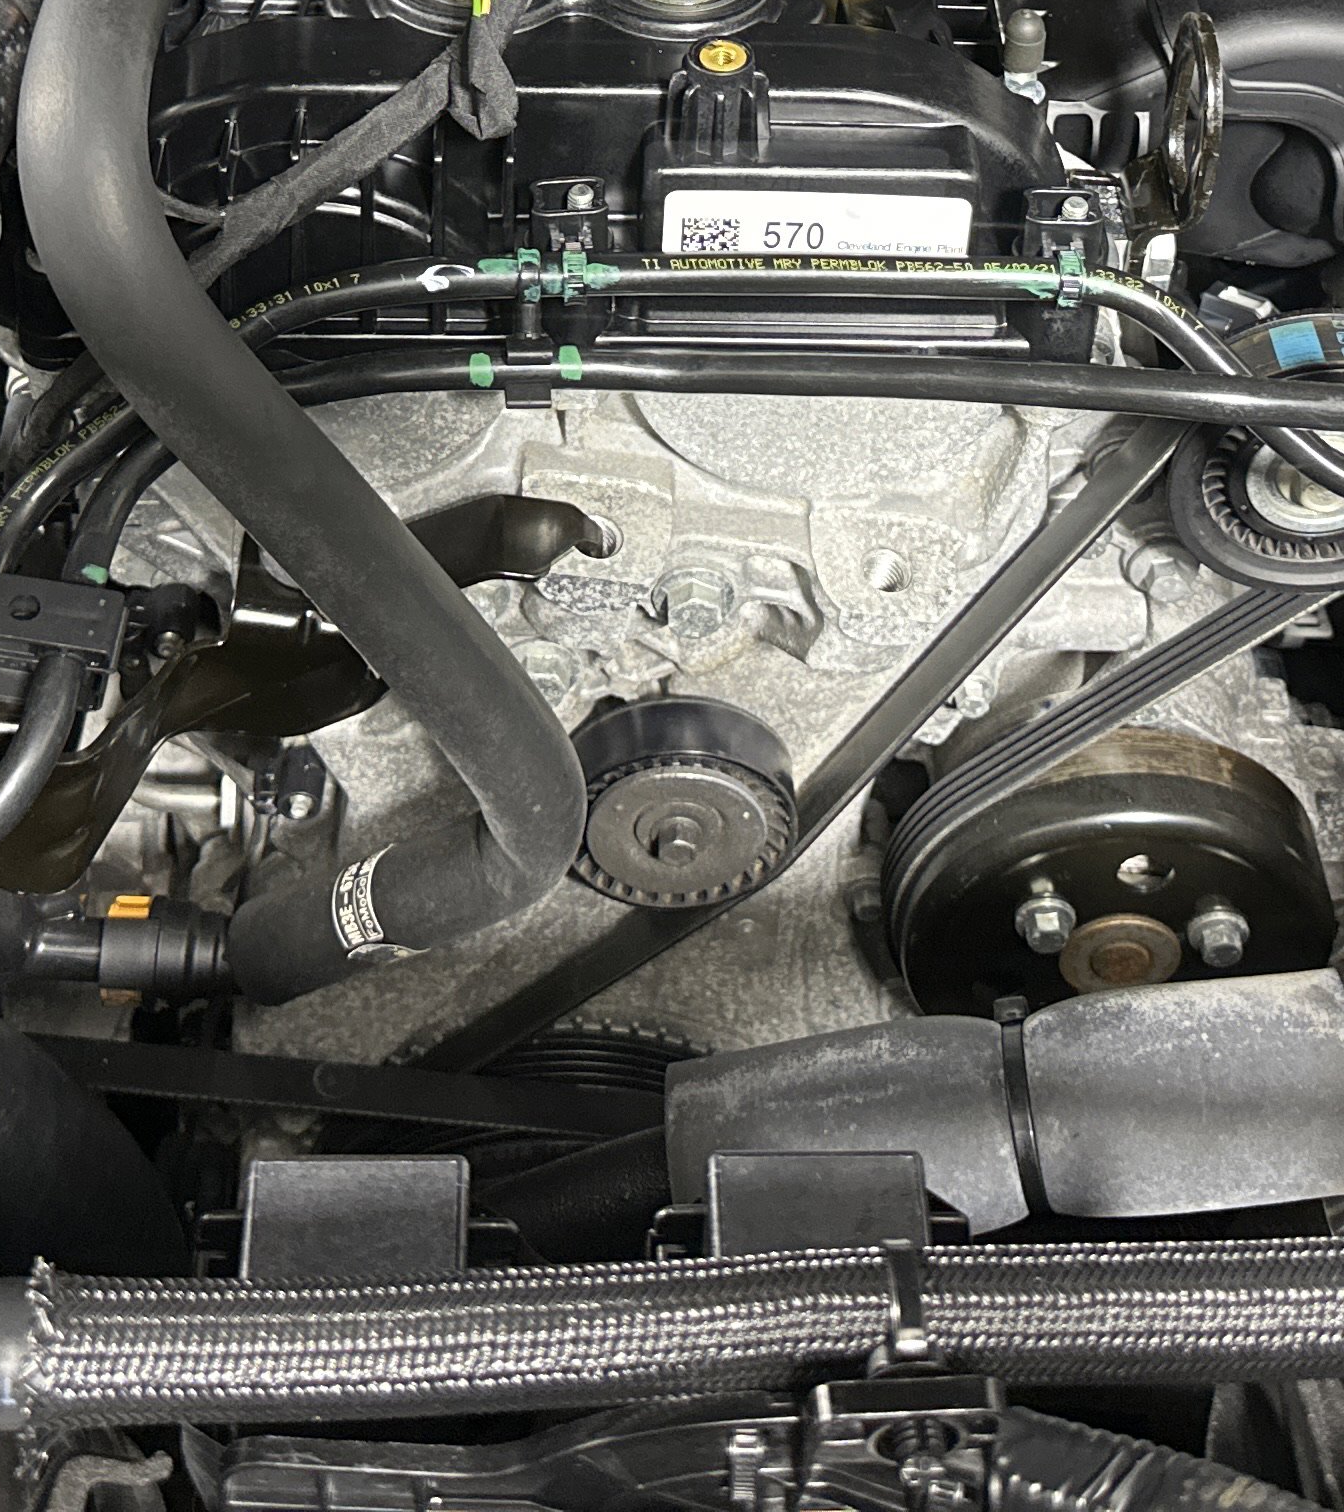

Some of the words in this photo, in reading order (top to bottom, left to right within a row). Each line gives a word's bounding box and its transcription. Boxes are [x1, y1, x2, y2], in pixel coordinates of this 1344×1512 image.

[763, 222, 824, 250] 570
[837, 241, 891, 252] Cleveland
[896, 243, 931, 254] Engine
[936, 244, 964, 254] Plant
[642, 258, 661, 270] TI
[670, 258, 765, 270] AUTOMOTIVE
[773, 258, 801, 269] MRY
[811, 258, 886, 270] PERMBLOK
[895, 261, 972, 272] PB562-50
[229, 291, 293, 329] 8:33:31
[350, 273, 360, 285] 7
[10, 440, 76, 501] PERMBLOK
[78, 402, 128, 441] PB562-
[357, 877, 379, 937] FoMoCo
